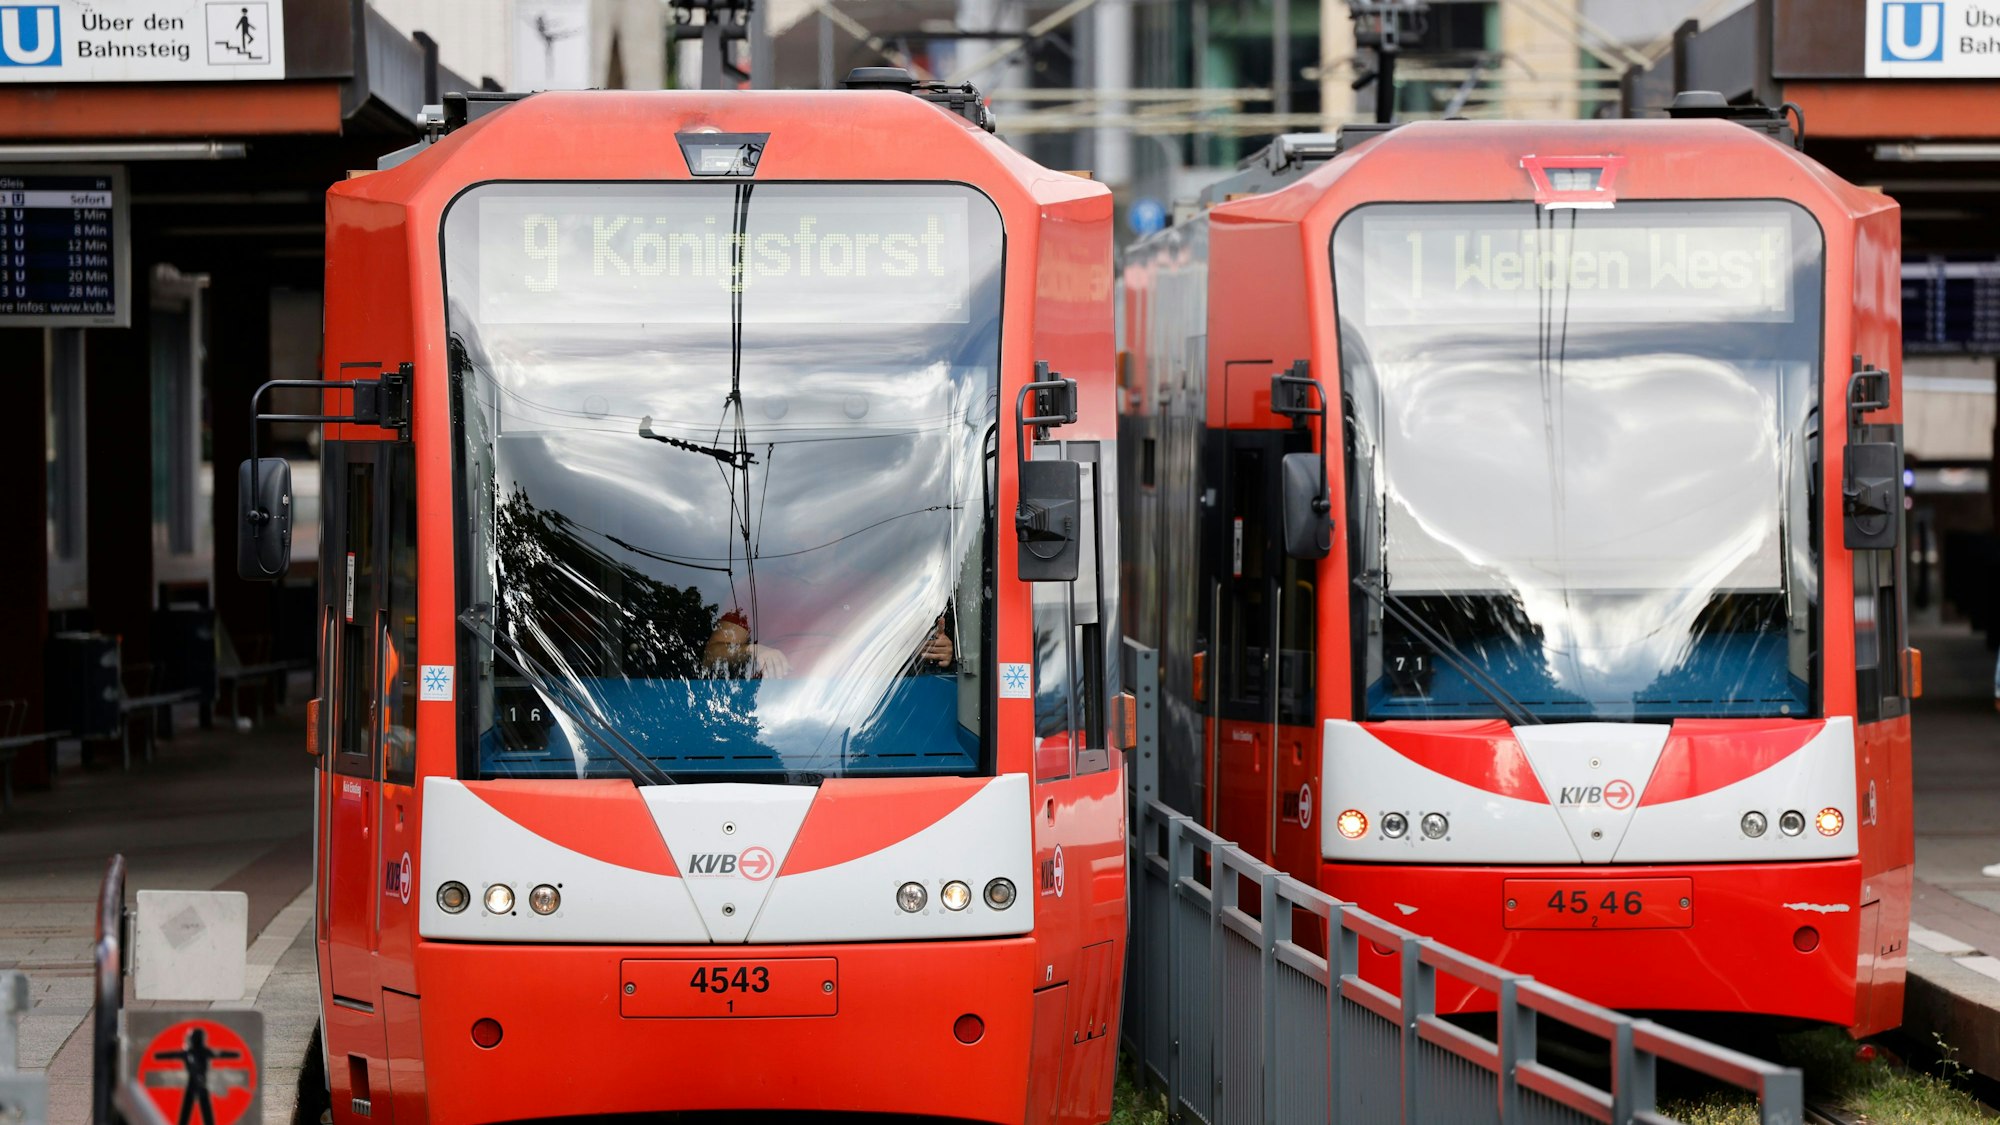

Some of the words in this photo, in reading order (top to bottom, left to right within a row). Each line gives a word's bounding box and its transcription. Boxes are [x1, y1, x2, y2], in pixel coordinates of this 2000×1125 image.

[82, 9, 133, 31] Über
[144, 14, 184, 31] den
[1, 8, 56, 64] U
[1886, 4, 1940, 60] U
[78, 40, 190, 61] Bahnsteig
[71, 193, 105, 205] Sofort
[84, 209, 106, 220] Min
[74, 224, 81, 236] 8
[84, 224, 107, 236] Min
[69, 239, 82, 251] 12
[85, 239, 107, 251] Min
[522, 214, 559, 292] 9
[592, 214, 946, 293] Königsforst
[69, 254, 82, 266] 13
[85, 254, 107, 266] Min
[1406, 232, 1423, 299] 1
[1455, 233, 1631, 290] Weiden
[1649, 233, 1777, 290] West
[69, 270, 82, 282] 20
[85, 270, 108, 282] Min
[69, 285, 82, 297] 28
[86, 285, 108, 297] Min
[1559, 786, 1602, 804] KVB
[689, 854, 737, 874] KVB
[386, 861, 400, 891] KVB
[1041, 860, 1054, 890] KVB
[1591, 916, 1599, 928] 2
[690, 966, 770, 993] 4543
[726, 1000, 734, 1013] 1
